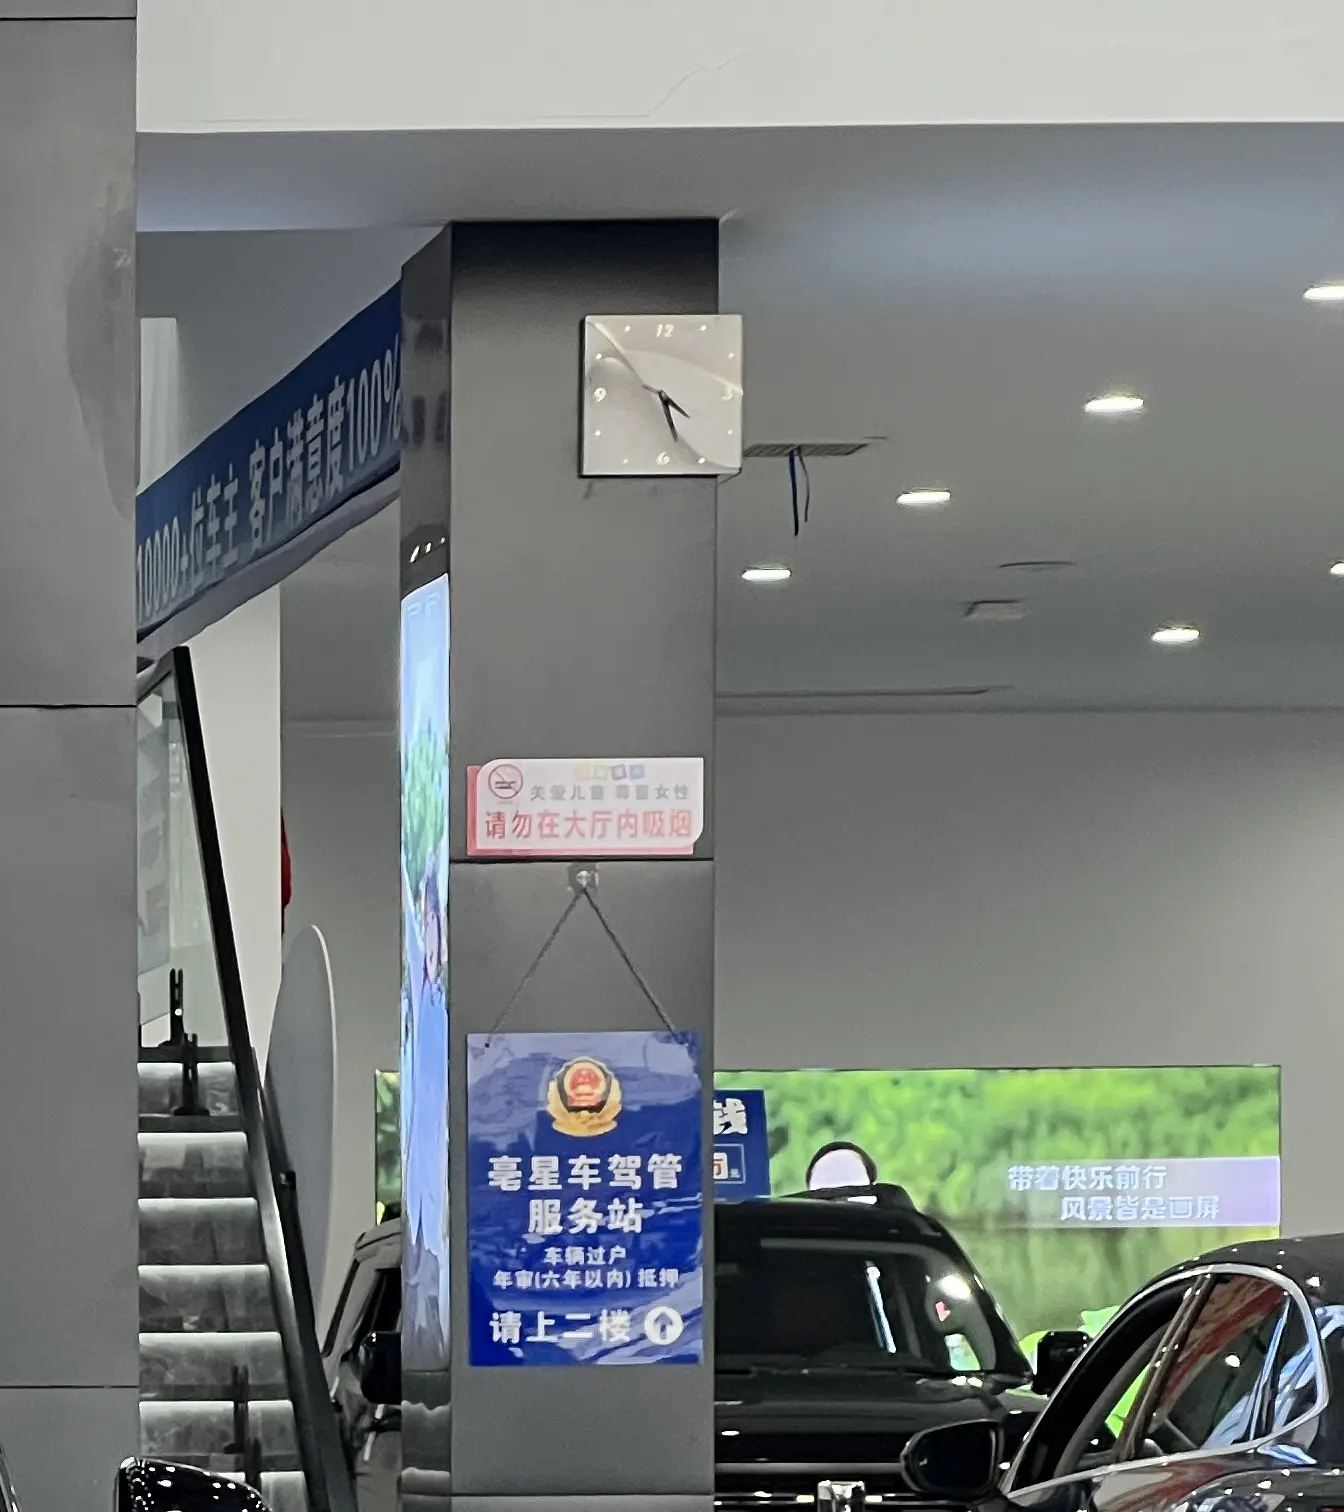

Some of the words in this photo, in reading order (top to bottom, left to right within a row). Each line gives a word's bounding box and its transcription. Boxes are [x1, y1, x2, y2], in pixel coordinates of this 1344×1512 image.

[485, 808, 693, 840] 请勿在大厅内吸烟
[1007, 1164, 1168, 1192] 带着快乐前行
[527, 1196, 645, 1236] 服务站
[1060, 1194, 1220, 1222] 风景皆是画屏
[544, 1245, 627, 1266] 车辆过户
[489, 1308, 632, 1344] 请上二楼
